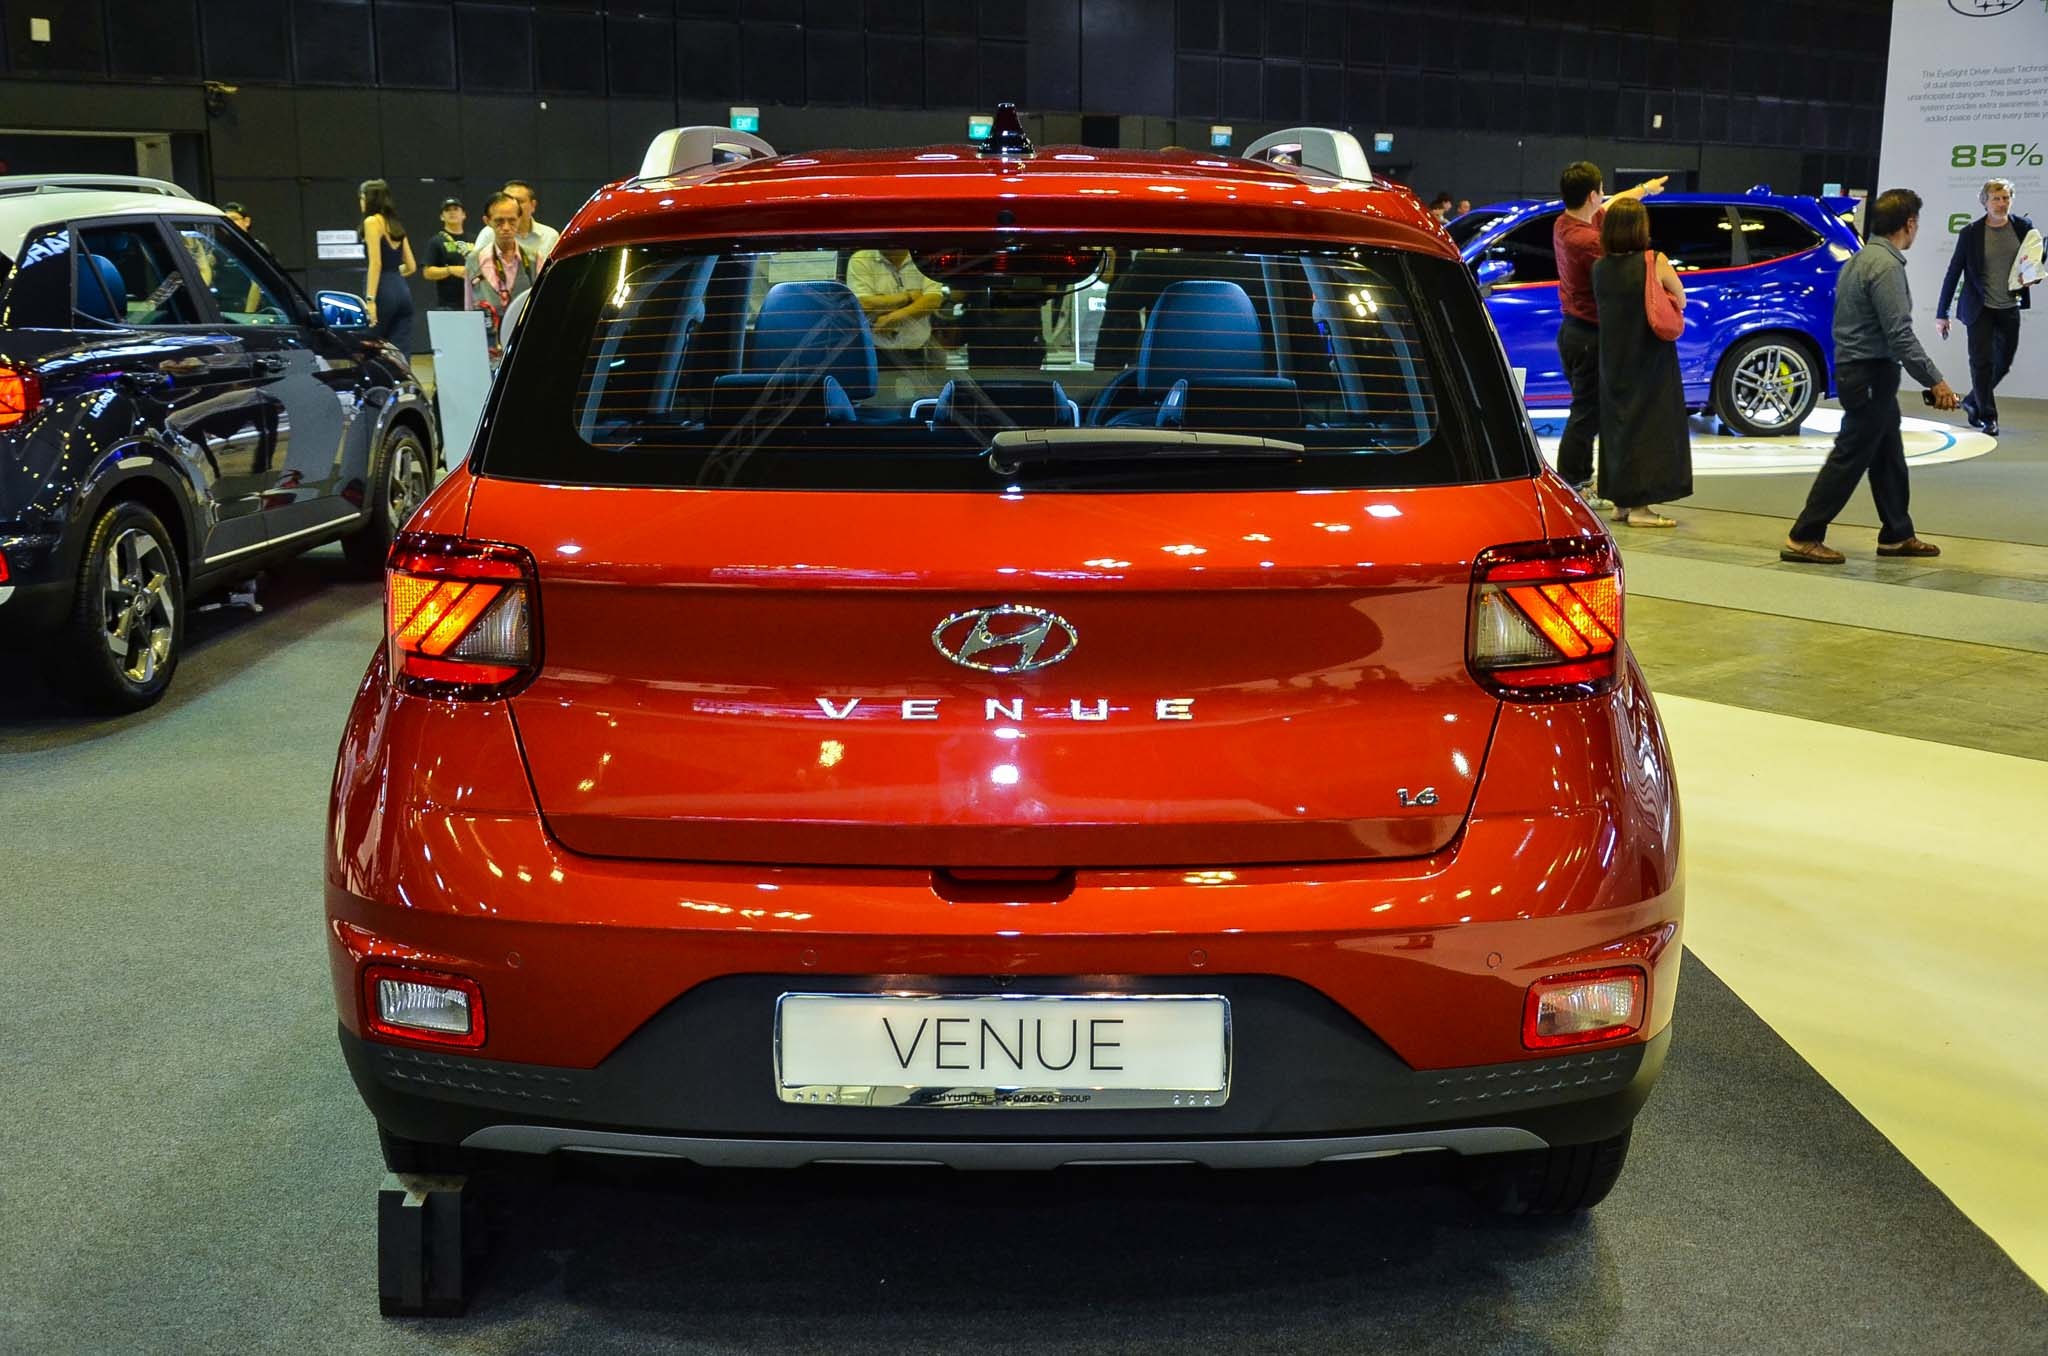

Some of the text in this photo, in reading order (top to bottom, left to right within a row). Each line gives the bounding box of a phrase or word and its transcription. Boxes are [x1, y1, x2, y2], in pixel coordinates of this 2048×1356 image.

[1951, 143, 2043, 168] 85%
[816, 698, 1195, 721] VENUE
[1396, 786, 1439, 806] 1.6
[882, 1018, 1124, 1071] VENUE
[1059, 1094, 1091, 1104] GROUP
